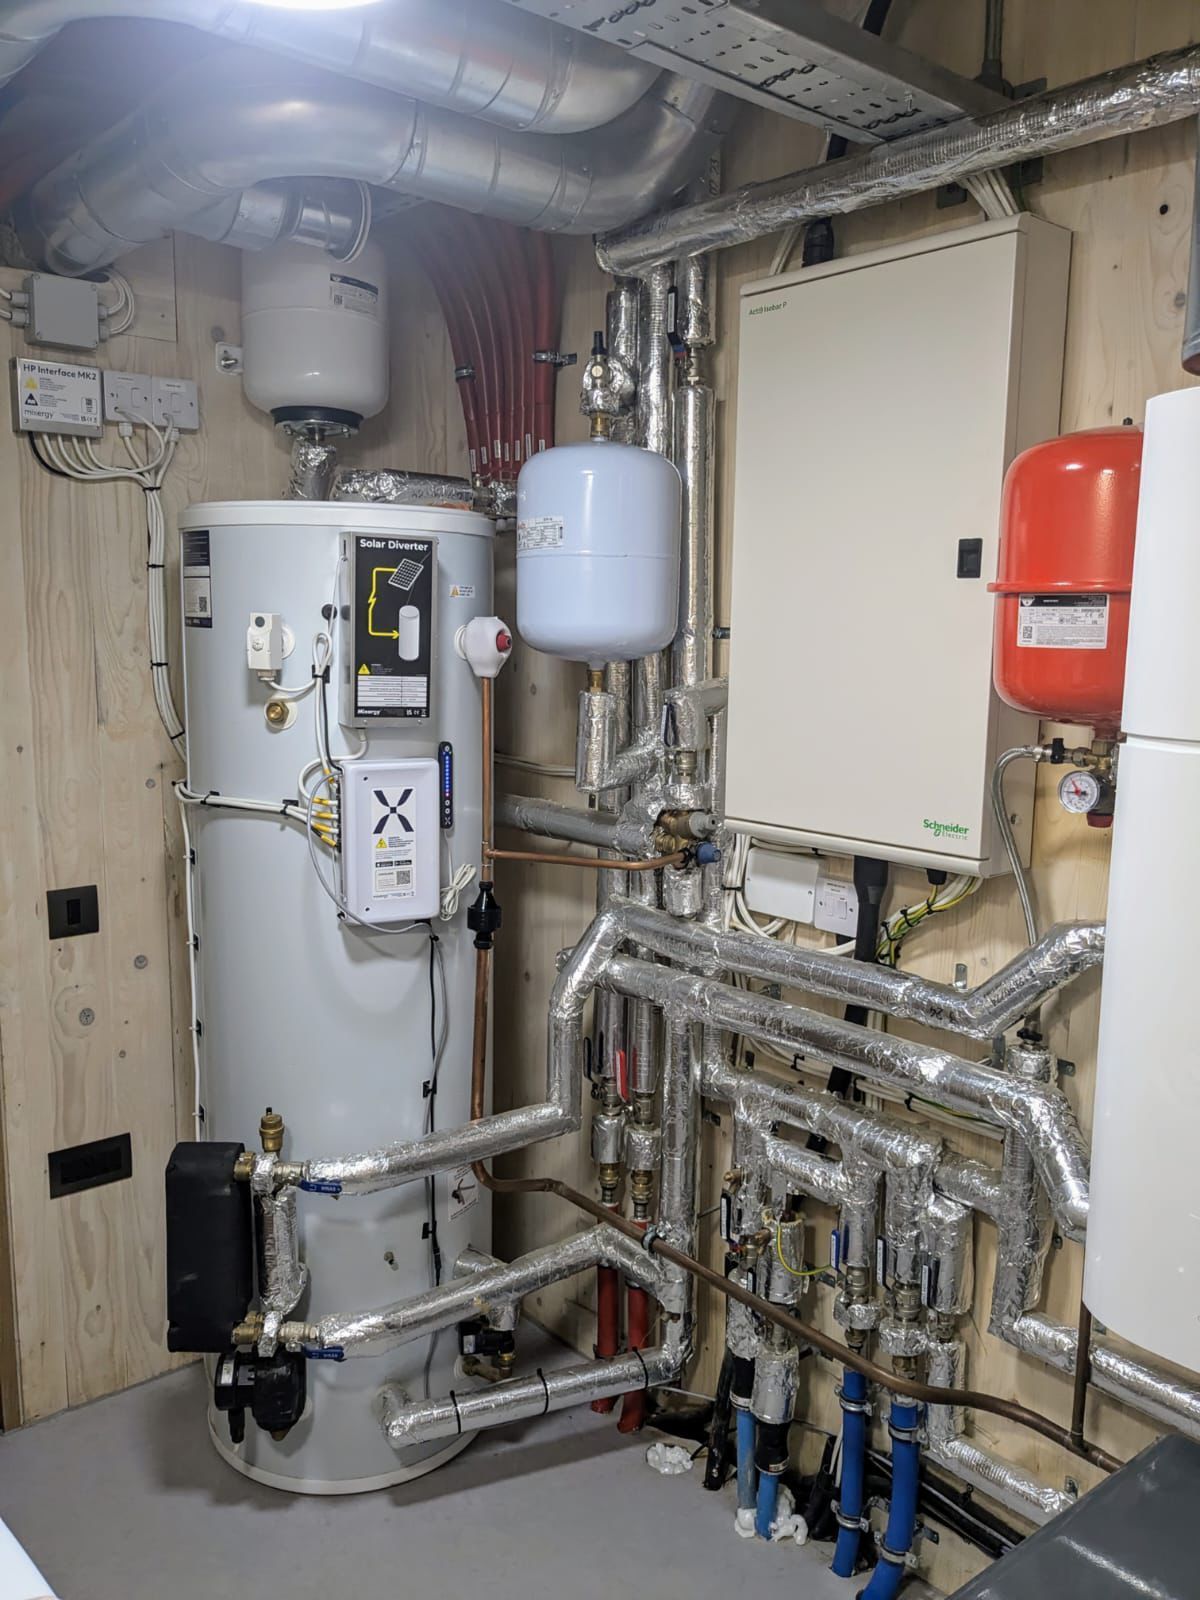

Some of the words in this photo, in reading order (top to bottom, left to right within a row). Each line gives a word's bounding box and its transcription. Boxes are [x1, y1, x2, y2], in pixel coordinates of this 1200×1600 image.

[23, 364, 36, 372] HP
[38, 366, 76, 378] Interface
[77, 371, 97, 380] MK2
[360, 538, 386, 548] Solar
[388, 540, 428, 551] Diverter
[923, 818, 969, 834] Schneider
